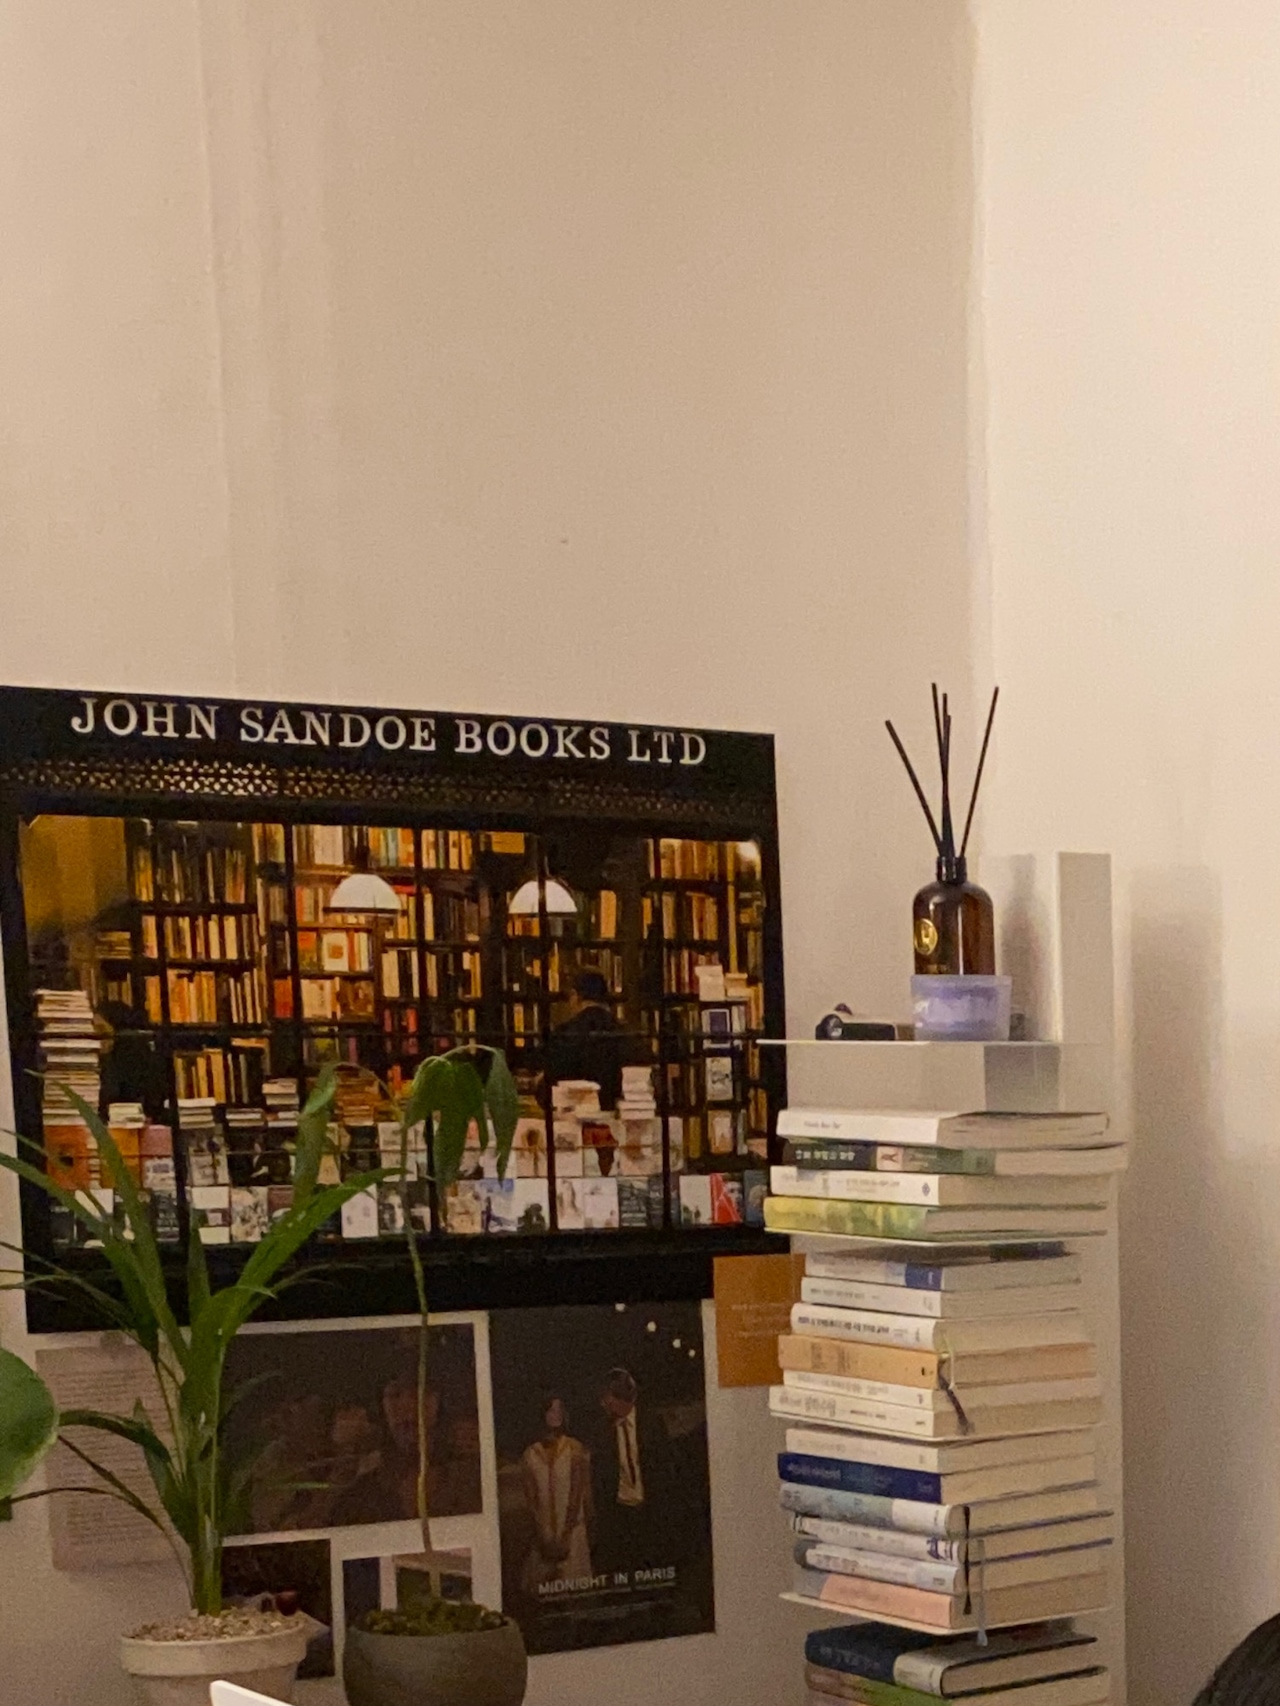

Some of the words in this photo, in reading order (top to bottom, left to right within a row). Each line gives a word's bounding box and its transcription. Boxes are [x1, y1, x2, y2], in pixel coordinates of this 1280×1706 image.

[70, 697, 220, 740] JOHN
[239, 706, 438, 753] SANDOE
[453, 718, 612, 761] BOOKS
[626, 729, 707, 767] LTD
[538, 1574, 609, 1594] MIDNIGHT
[613, 1572, 630, 1586] IN
[634, 1566, 676, 1582] PARIS
